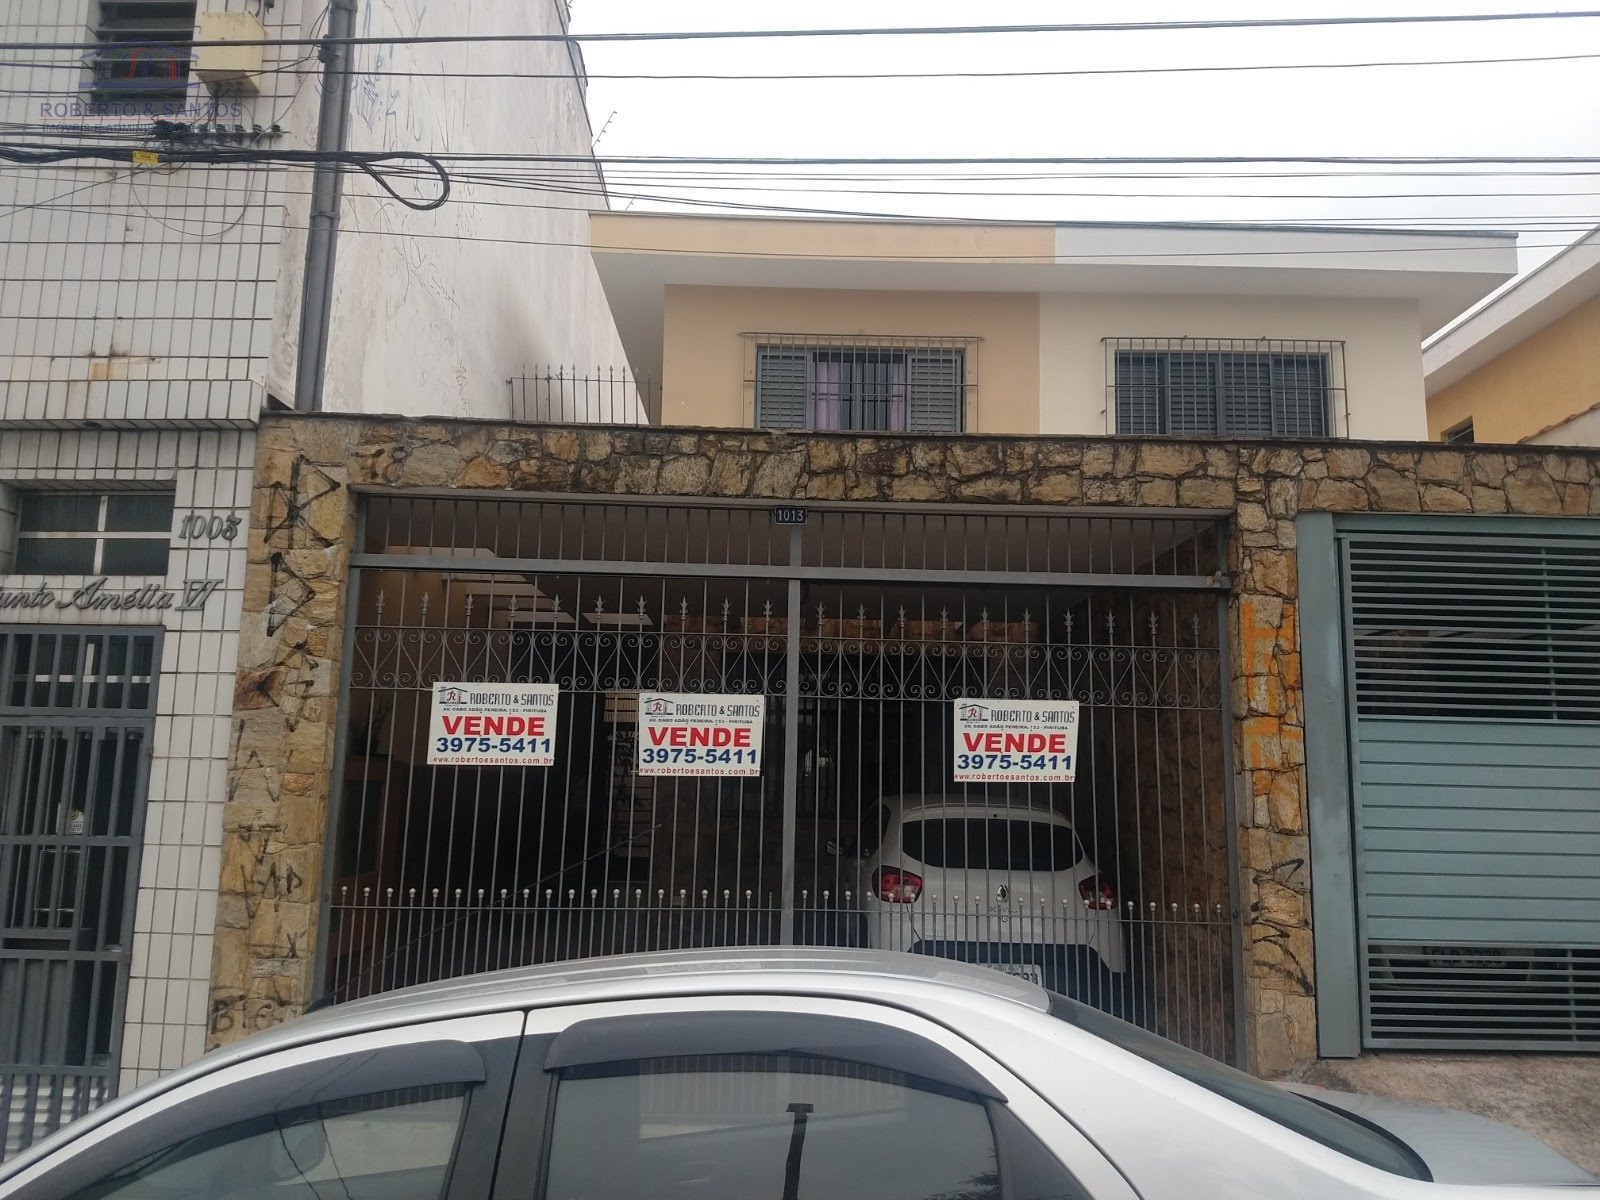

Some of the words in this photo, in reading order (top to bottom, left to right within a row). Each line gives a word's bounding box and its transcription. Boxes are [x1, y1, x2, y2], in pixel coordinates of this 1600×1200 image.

[778, 509, 804, 522] 1013
[178, 514, 243, 540] 1003
[0, 582, 55, 608] unto
[55, 577, 175, 610] Amélia
[175, 579, 223, 611] VI
[470, 692, 511, 706] ROBERTO
[513, 695, 519, 704] &
[521, 693, 554, 707] SANTOS
[676, 703, 717, 716] ROBERTO
[719, 706, 725, 715] &
[727, 704, 760, 717] SANTOS
[991, 709, 1032, 722] ROBERTO
[1034, 712, 1040, 721] &
[1042, 710, 1075, 723] SANTOS
[442, 716, 545, 736] VENDE
[436, 737, 551, 753] 3975-5411
[648, 727, 751, 747] VENDE
[963, 733, 1066, 753] VENDE
[432, 756, 554, 765] www.robertoesantos.com.br
[642, 748, 756, 764] 3975-5411
[957, 754, 1071, 770] 3975-5411
[639, 767, 759, 775] www.robertoesantos.com.br
[954, 773, 1074, 781] www.robertoesantos.com.br
